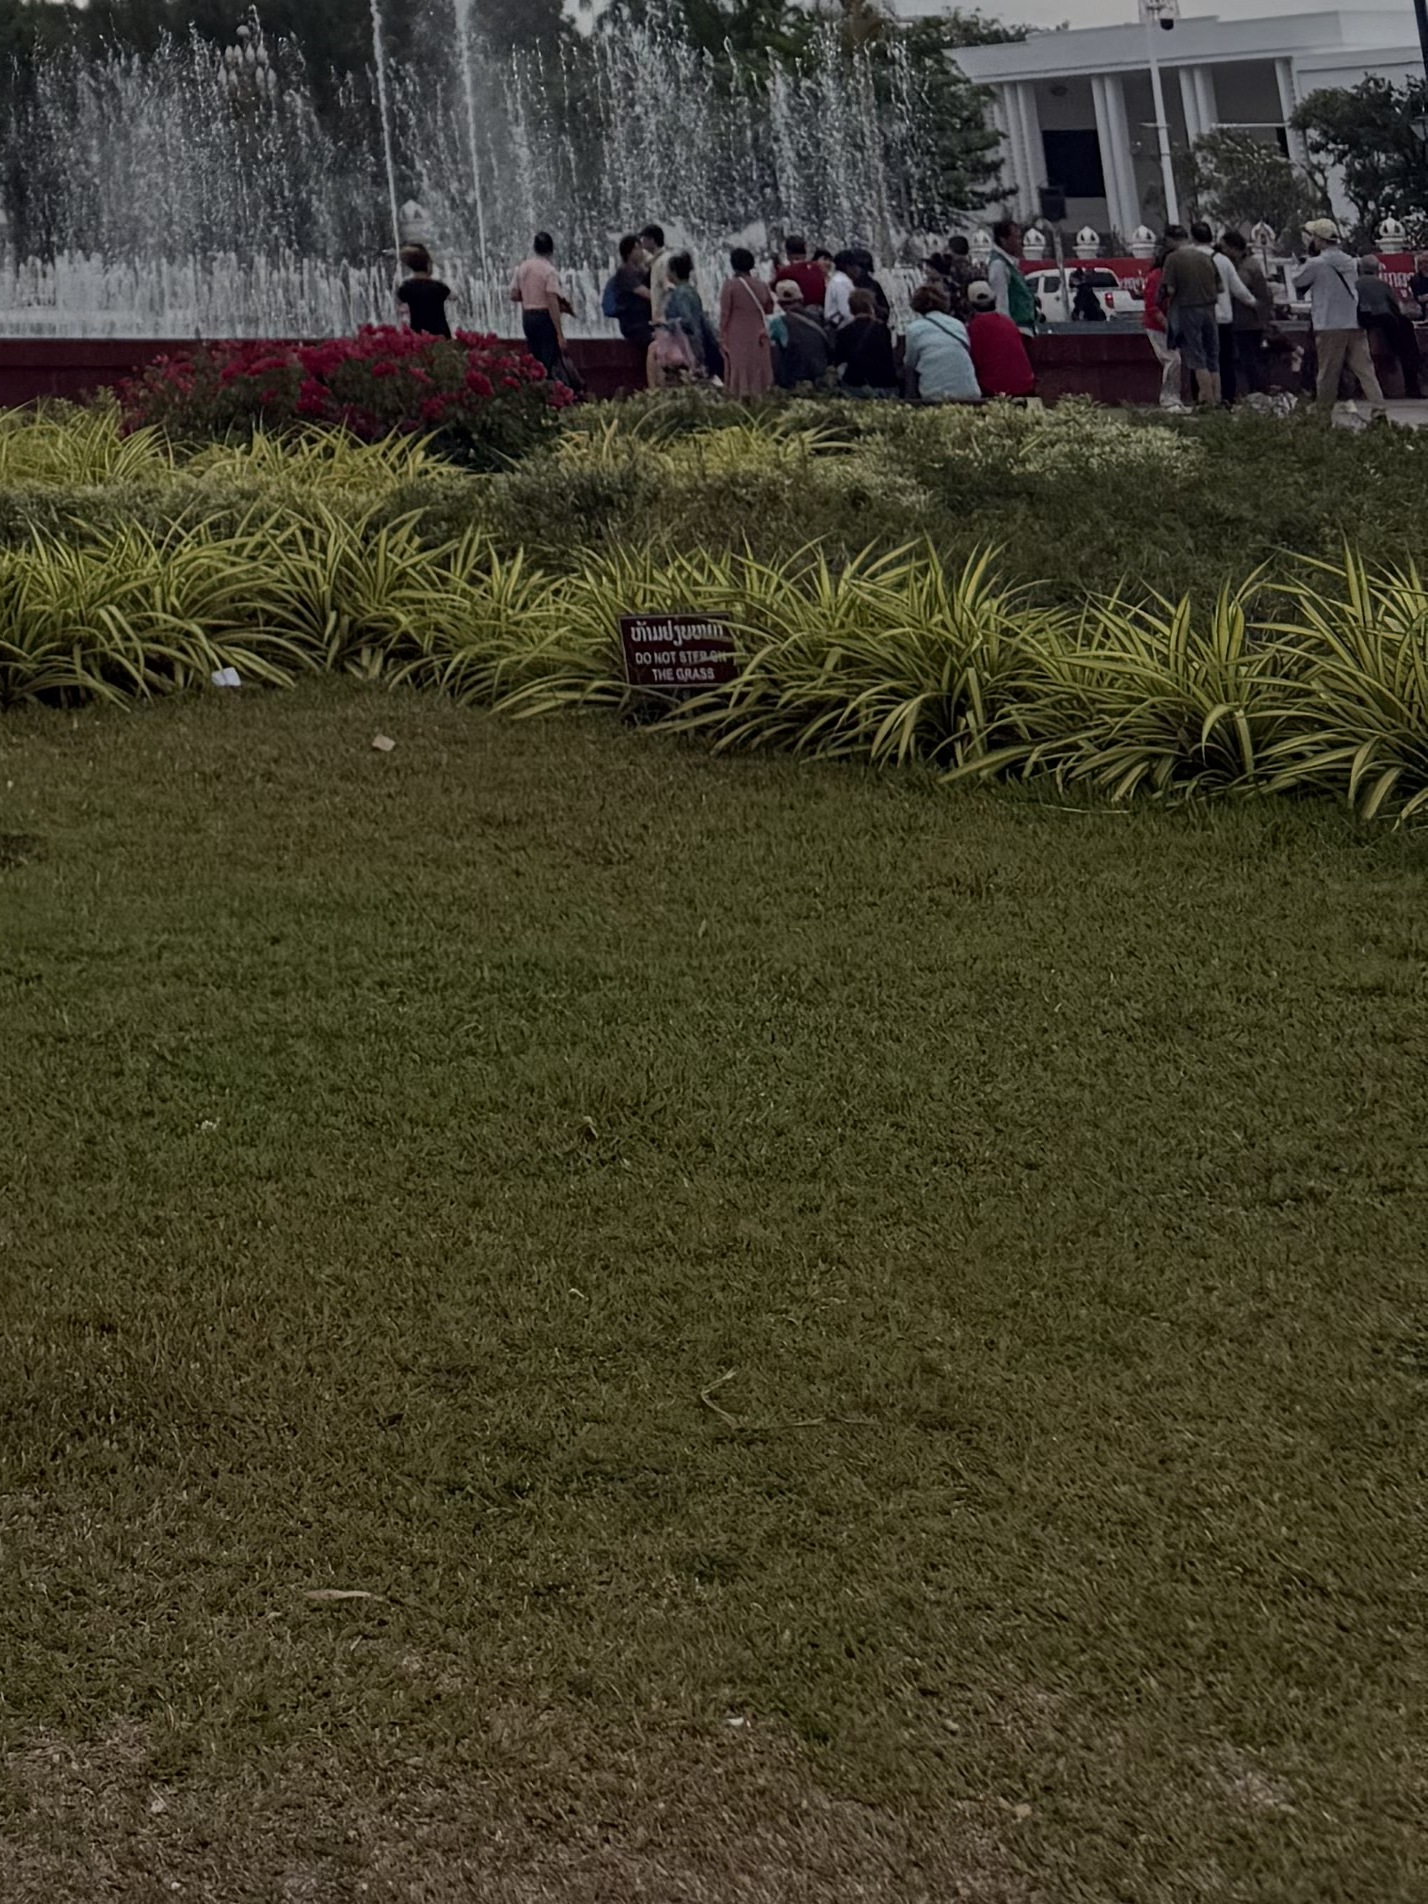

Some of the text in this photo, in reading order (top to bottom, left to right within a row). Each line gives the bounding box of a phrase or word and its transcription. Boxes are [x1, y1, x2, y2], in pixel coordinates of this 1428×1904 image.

[635, 652, 652, 665] DO
[654, 651, 676, 665] NOT
[679, 650, 707, 665] STEP
[652, 667, 716, 682] THE GRASS
